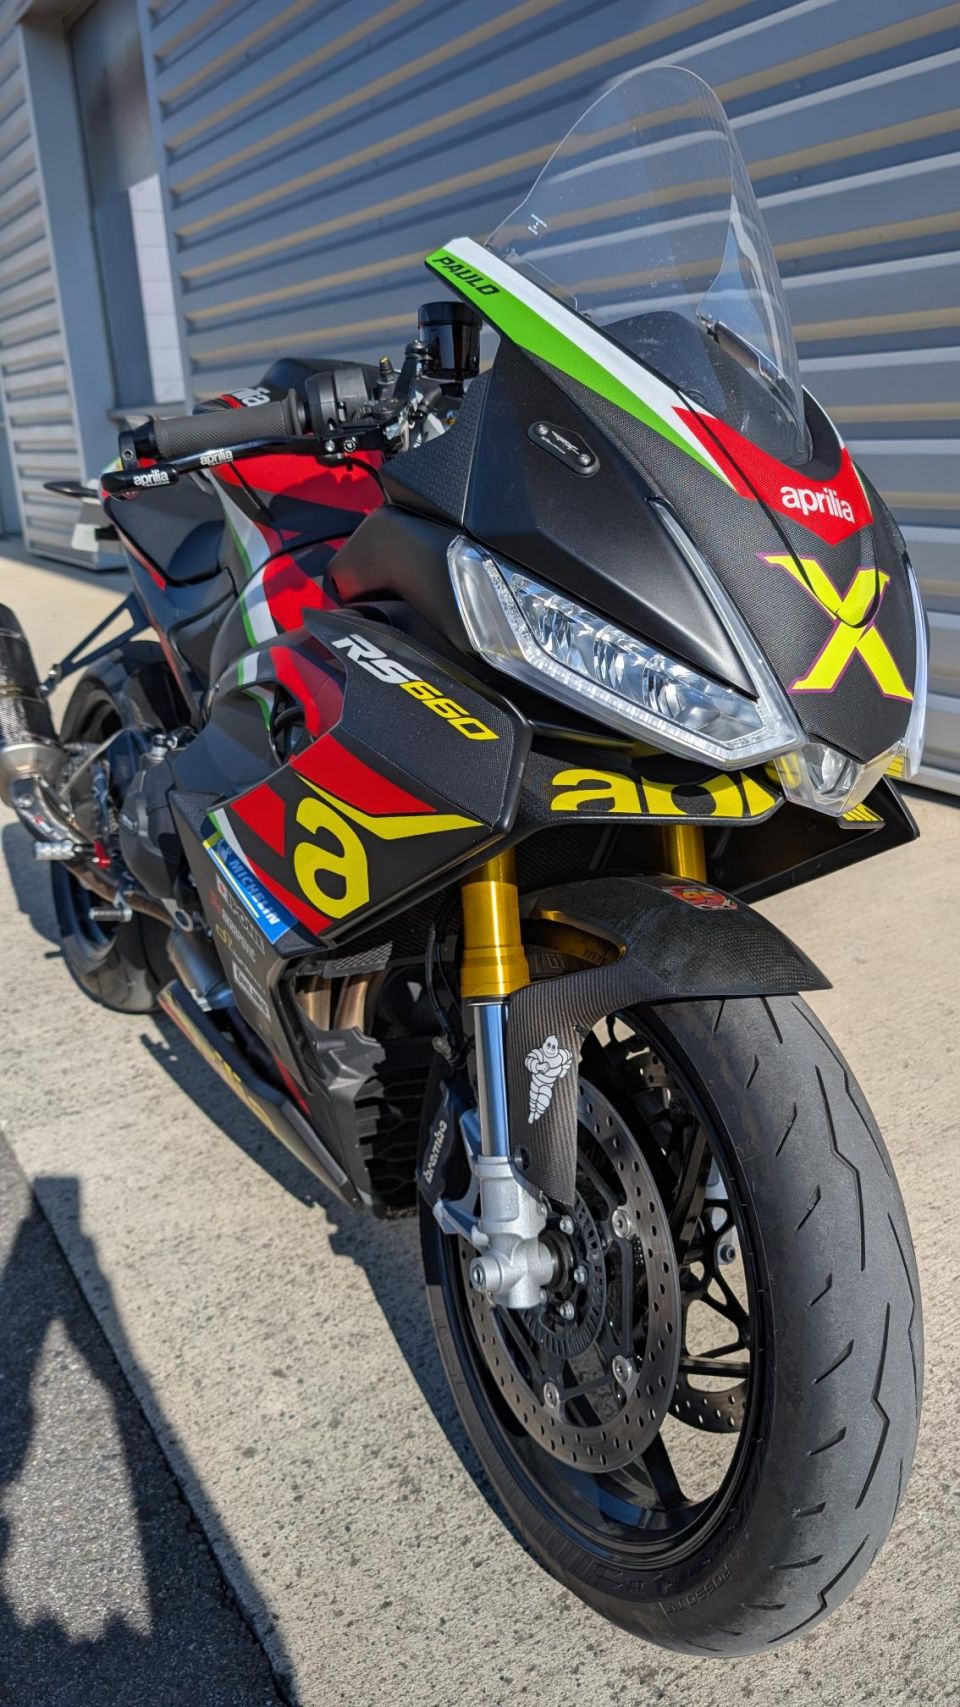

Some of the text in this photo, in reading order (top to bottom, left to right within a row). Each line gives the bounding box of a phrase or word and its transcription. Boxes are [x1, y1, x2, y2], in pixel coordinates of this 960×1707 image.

[133, 468, 170, 487] aprilia
[200, 450, 233, 466] aprilia
[780, 485, 855, 524] aprilia
[757, 552, 913, 703] X
[229, 859, 281, 926] MICHELIN
[423, 1119, 448, 1185] brembo
